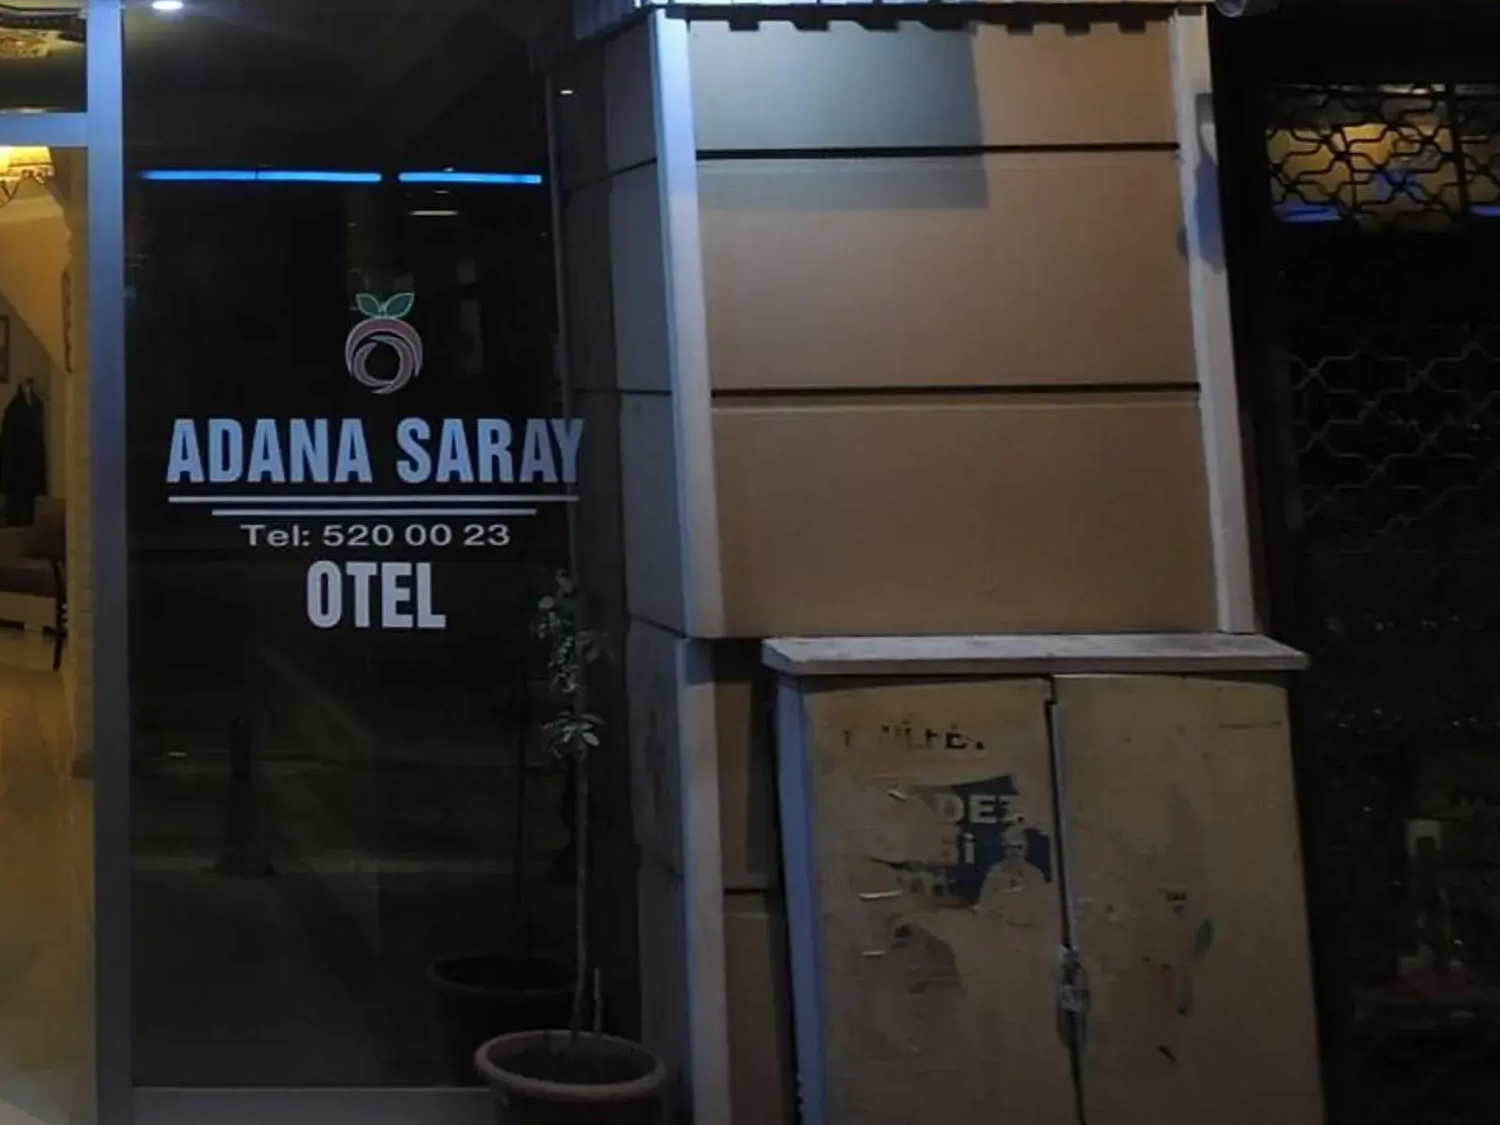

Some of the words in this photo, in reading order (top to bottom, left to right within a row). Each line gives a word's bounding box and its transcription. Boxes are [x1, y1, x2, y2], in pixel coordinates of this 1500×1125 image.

[166, 418, 373, 483] ADANA
[397, 417, 585, 483] SARAY
[240, 524, 311, 546] Tel:
[322, 524, 394, 547] 520
[405, 524, 452, 546] 00
[463, 523, 511, 546] 23
[306, 559, 447, 629] OTEL
